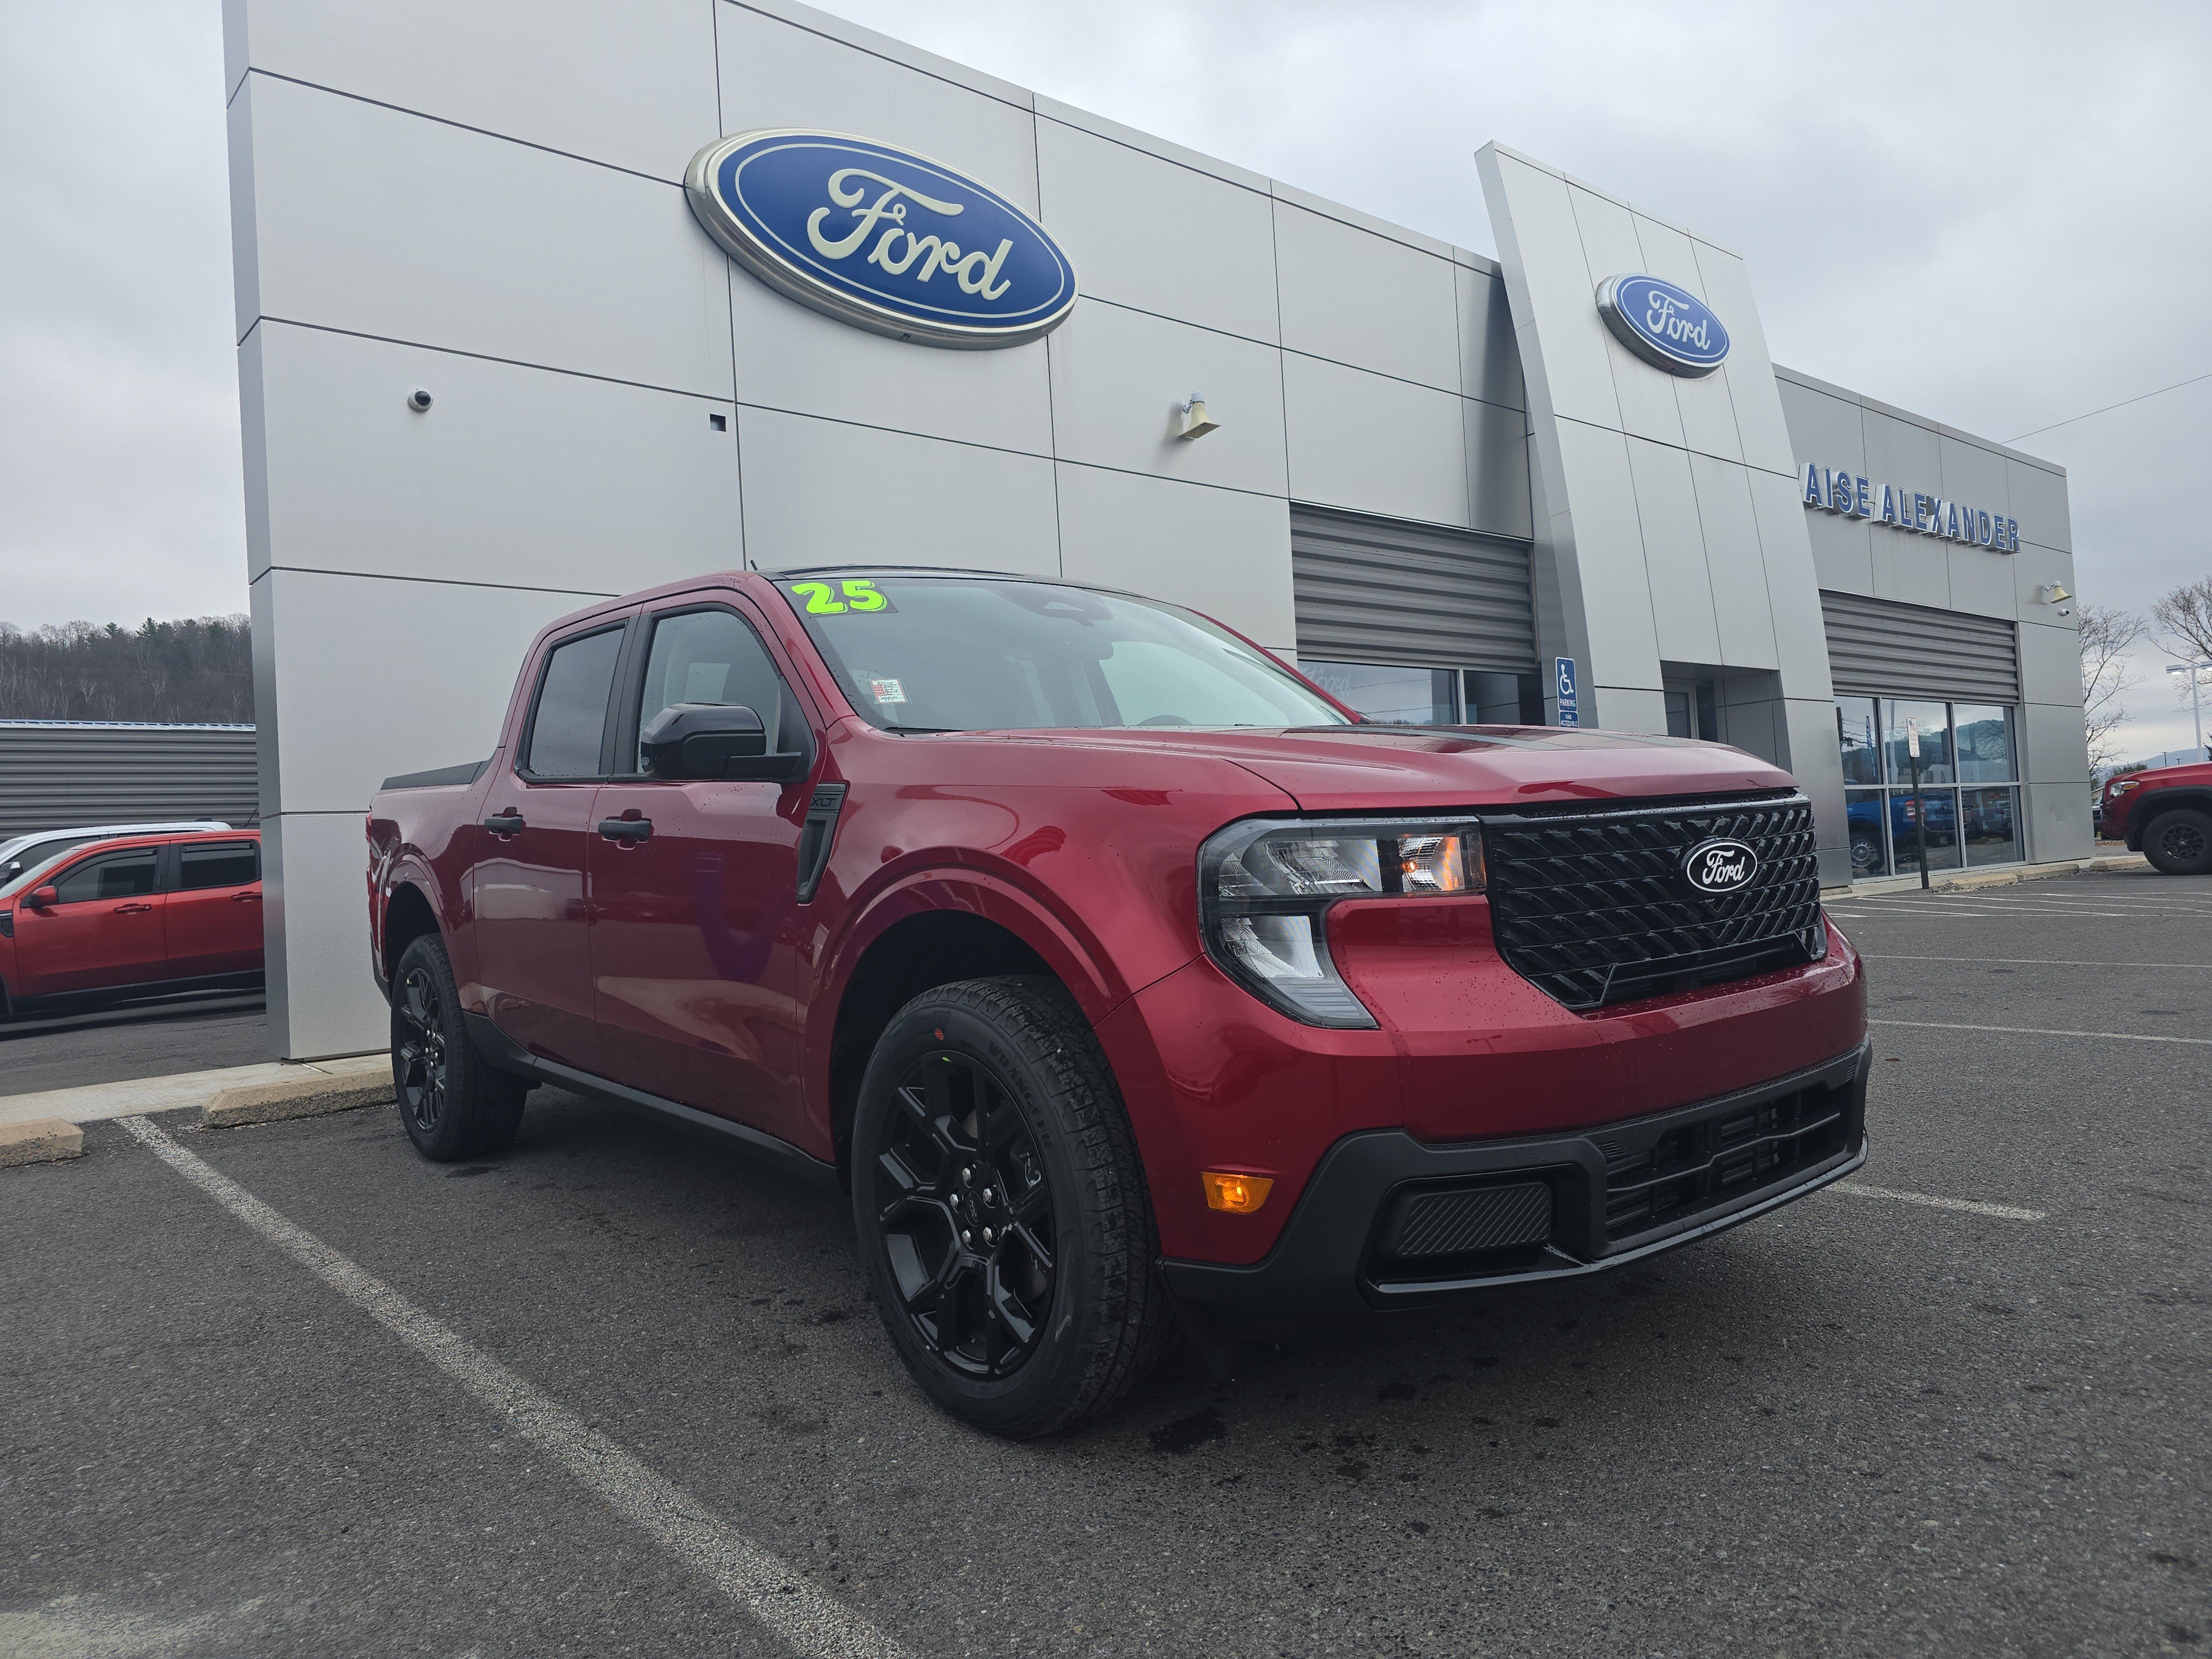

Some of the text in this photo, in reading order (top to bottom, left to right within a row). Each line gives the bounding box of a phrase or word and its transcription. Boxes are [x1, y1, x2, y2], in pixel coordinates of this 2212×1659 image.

[807, 168, 1013, 300] Ford
[1646, 290, 1711, 350] Ford
[1801, 461, 2021, 553] AISE ALEXANDER
[791, 580, 888, 614] 25
[1560, 698, 1576, 707] PARKING
[810, 797, 837, 808] XLT
[1702, 850, 1745, 884] Ford
[988, 1040, 1053, 1149] WRANGLER
